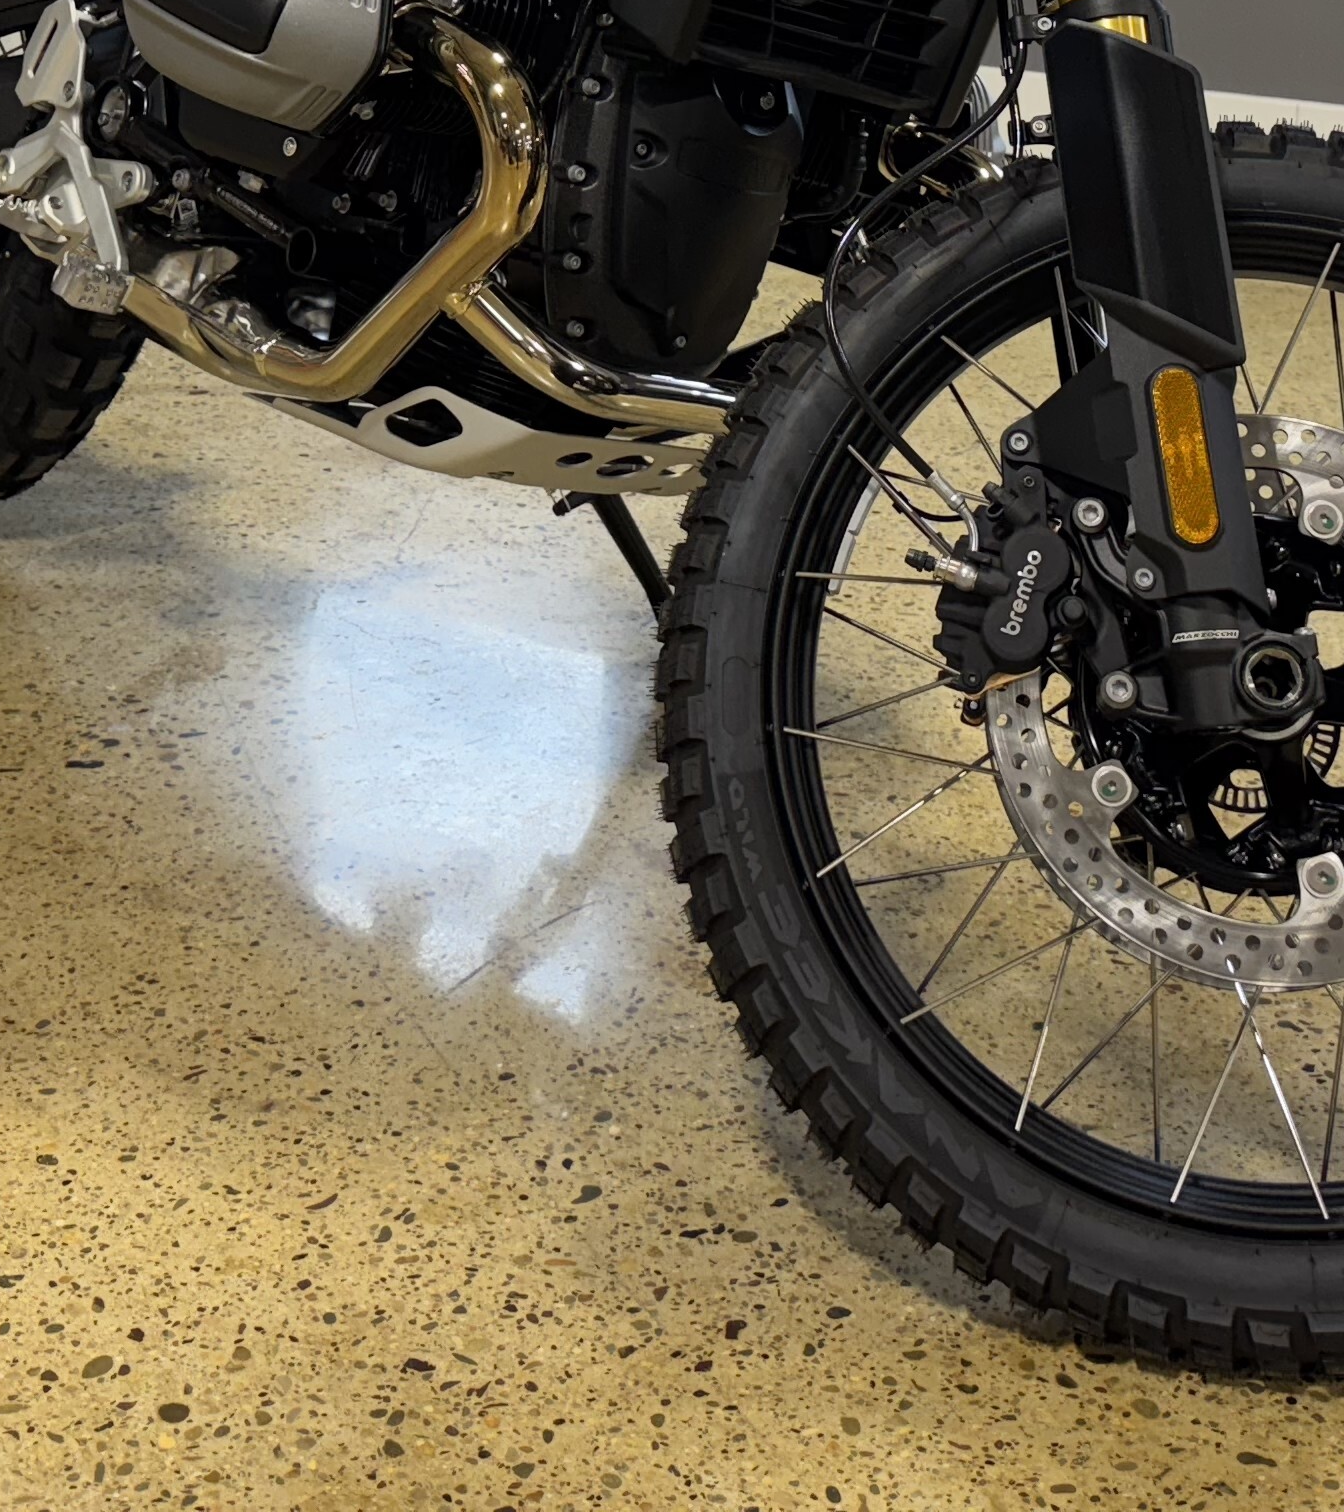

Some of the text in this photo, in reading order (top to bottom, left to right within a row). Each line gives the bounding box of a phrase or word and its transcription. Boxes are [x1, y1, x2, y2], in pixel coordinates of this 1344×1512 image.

[1000, 550, 1042, 636] brembo
[729, 777, 1045, 1209] ANAKEE WILD
